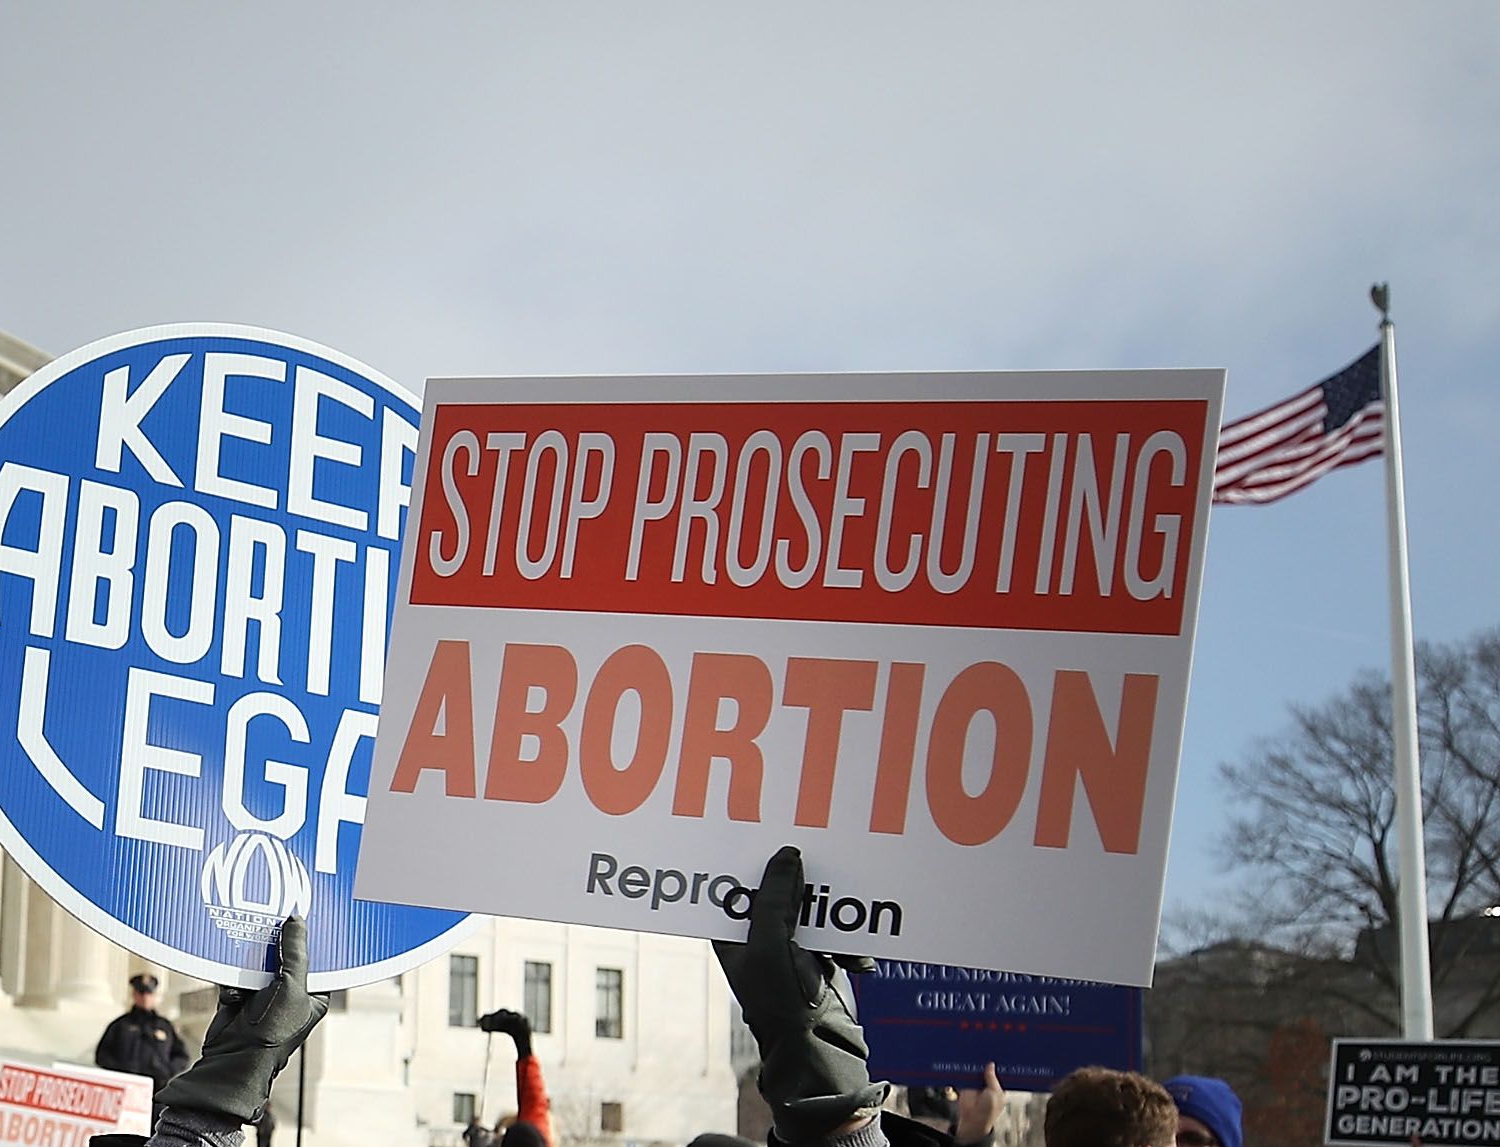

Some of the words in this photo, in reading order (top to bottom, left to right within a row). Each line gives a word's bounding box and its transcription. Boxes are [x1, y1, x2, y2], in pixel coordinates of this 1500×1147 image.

[428, 429, 615, 581] STOP
[625, 429, 1187, 601] PROSECUTING
[389, 639, 1160, 855] ABORTION
[586, 852, 903, 937] Reproation
[209, 908, 285, 927] NATION
[917, 991, 991, 1012] GREAT
[996, 994, 1071, 1016] AGAIN!
[1346, 1063, 1356, 1081] I
[1369, 1063, 1420, 1084] AM
[1435, 1064, 1499, 1086] THE
[1337, 1085, 1500, 1115] PRO-LIFE
[1338, 1114, 1500, 1140] GENERATION
